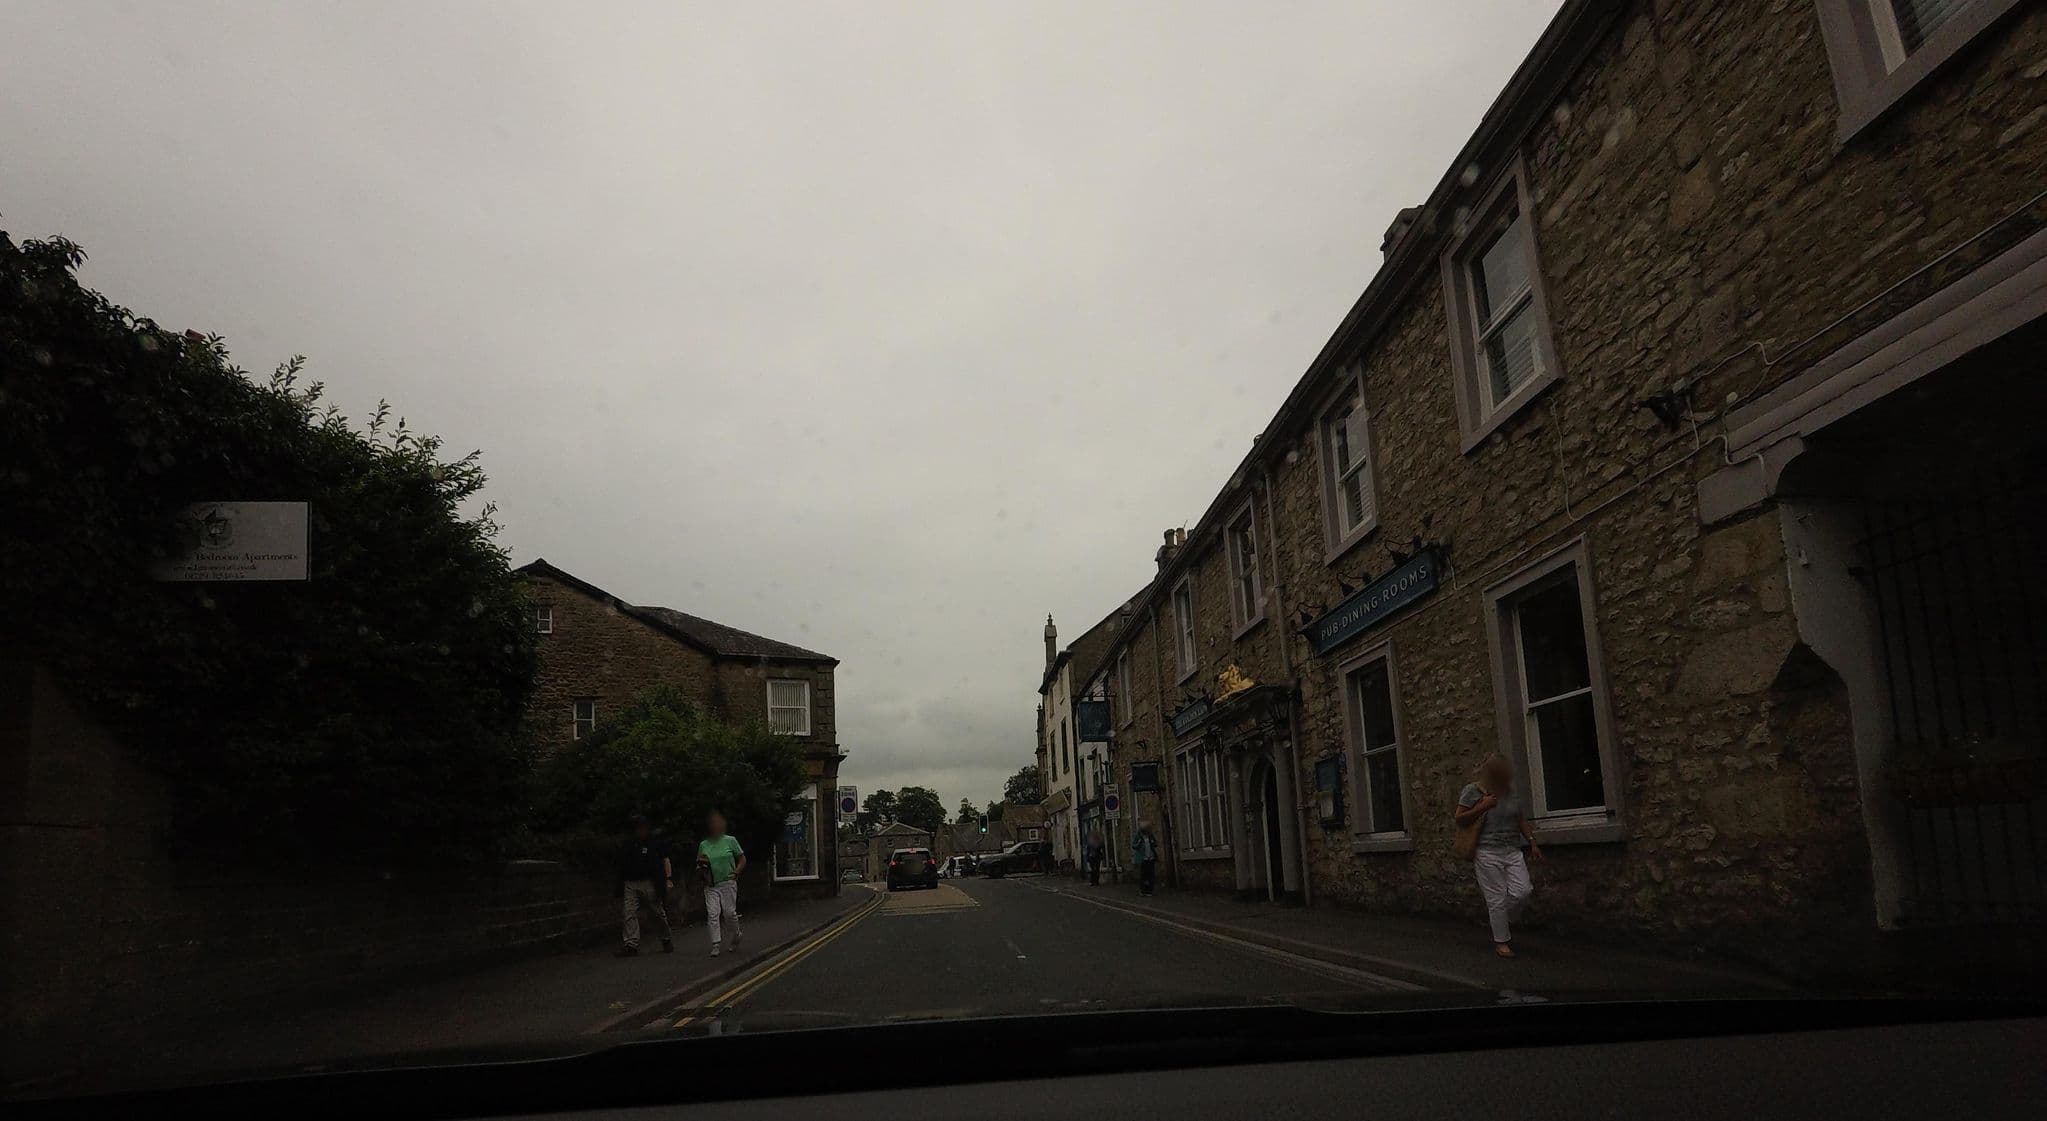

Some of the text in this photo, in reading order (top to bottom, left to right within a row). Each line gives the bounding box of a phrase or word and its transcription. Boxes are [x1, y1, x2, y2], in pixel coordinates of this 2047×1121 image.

[245, 552, 298, 564] Apartments
[1321, 565, 1427, 641] PUB DINING ROOMS
